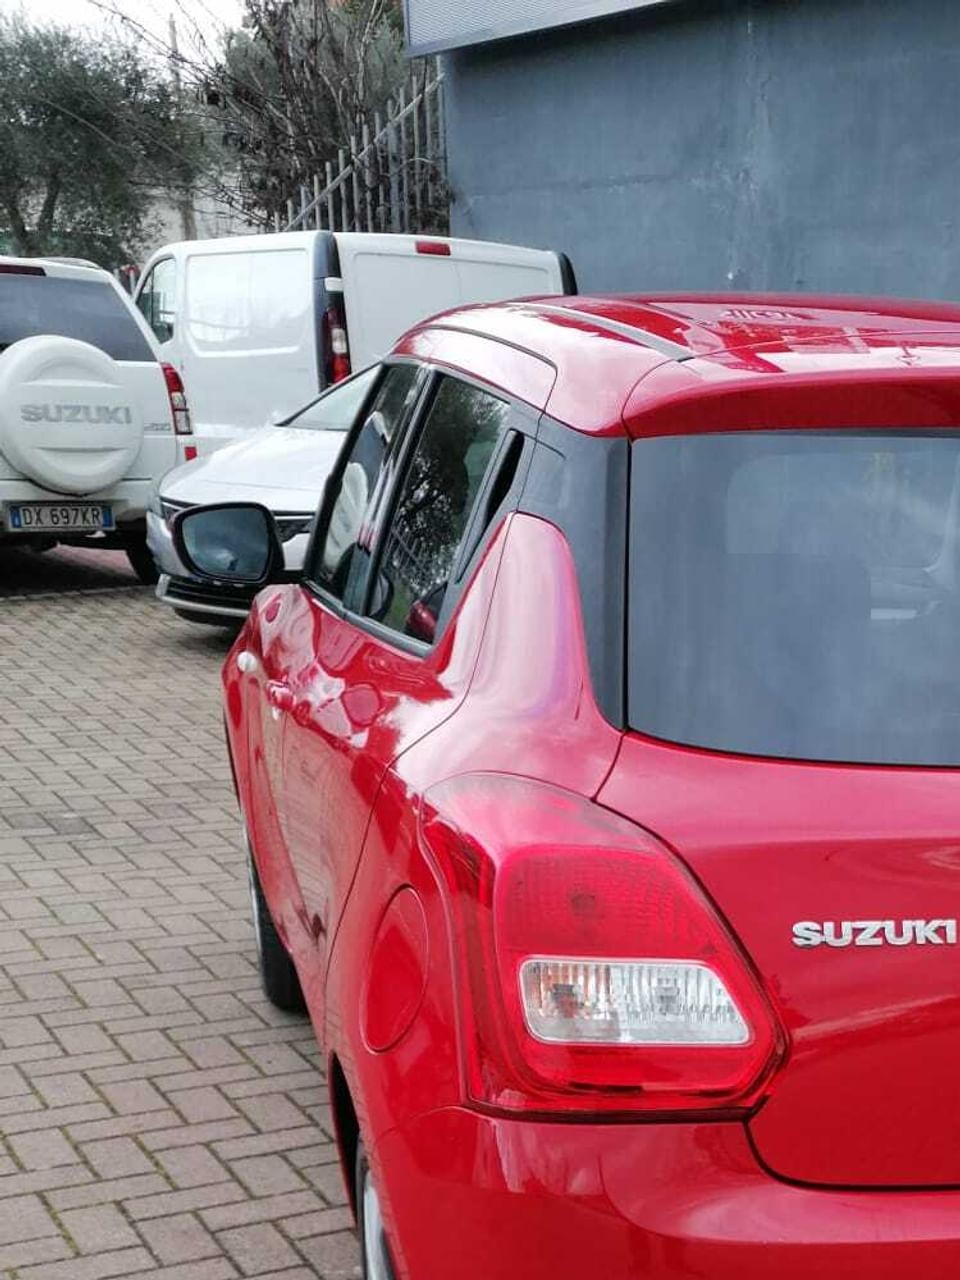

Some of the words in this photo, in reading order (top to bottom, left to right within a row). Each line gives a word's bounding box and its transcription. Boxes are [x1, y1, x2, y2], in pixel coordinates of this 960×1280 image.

[20, 404, 133, 425] SUZUKI
[21, 507, 44, 526] DX
[50, 507, 101, 526] 697KR
[791, 918, 958, 948] SUZUKI
